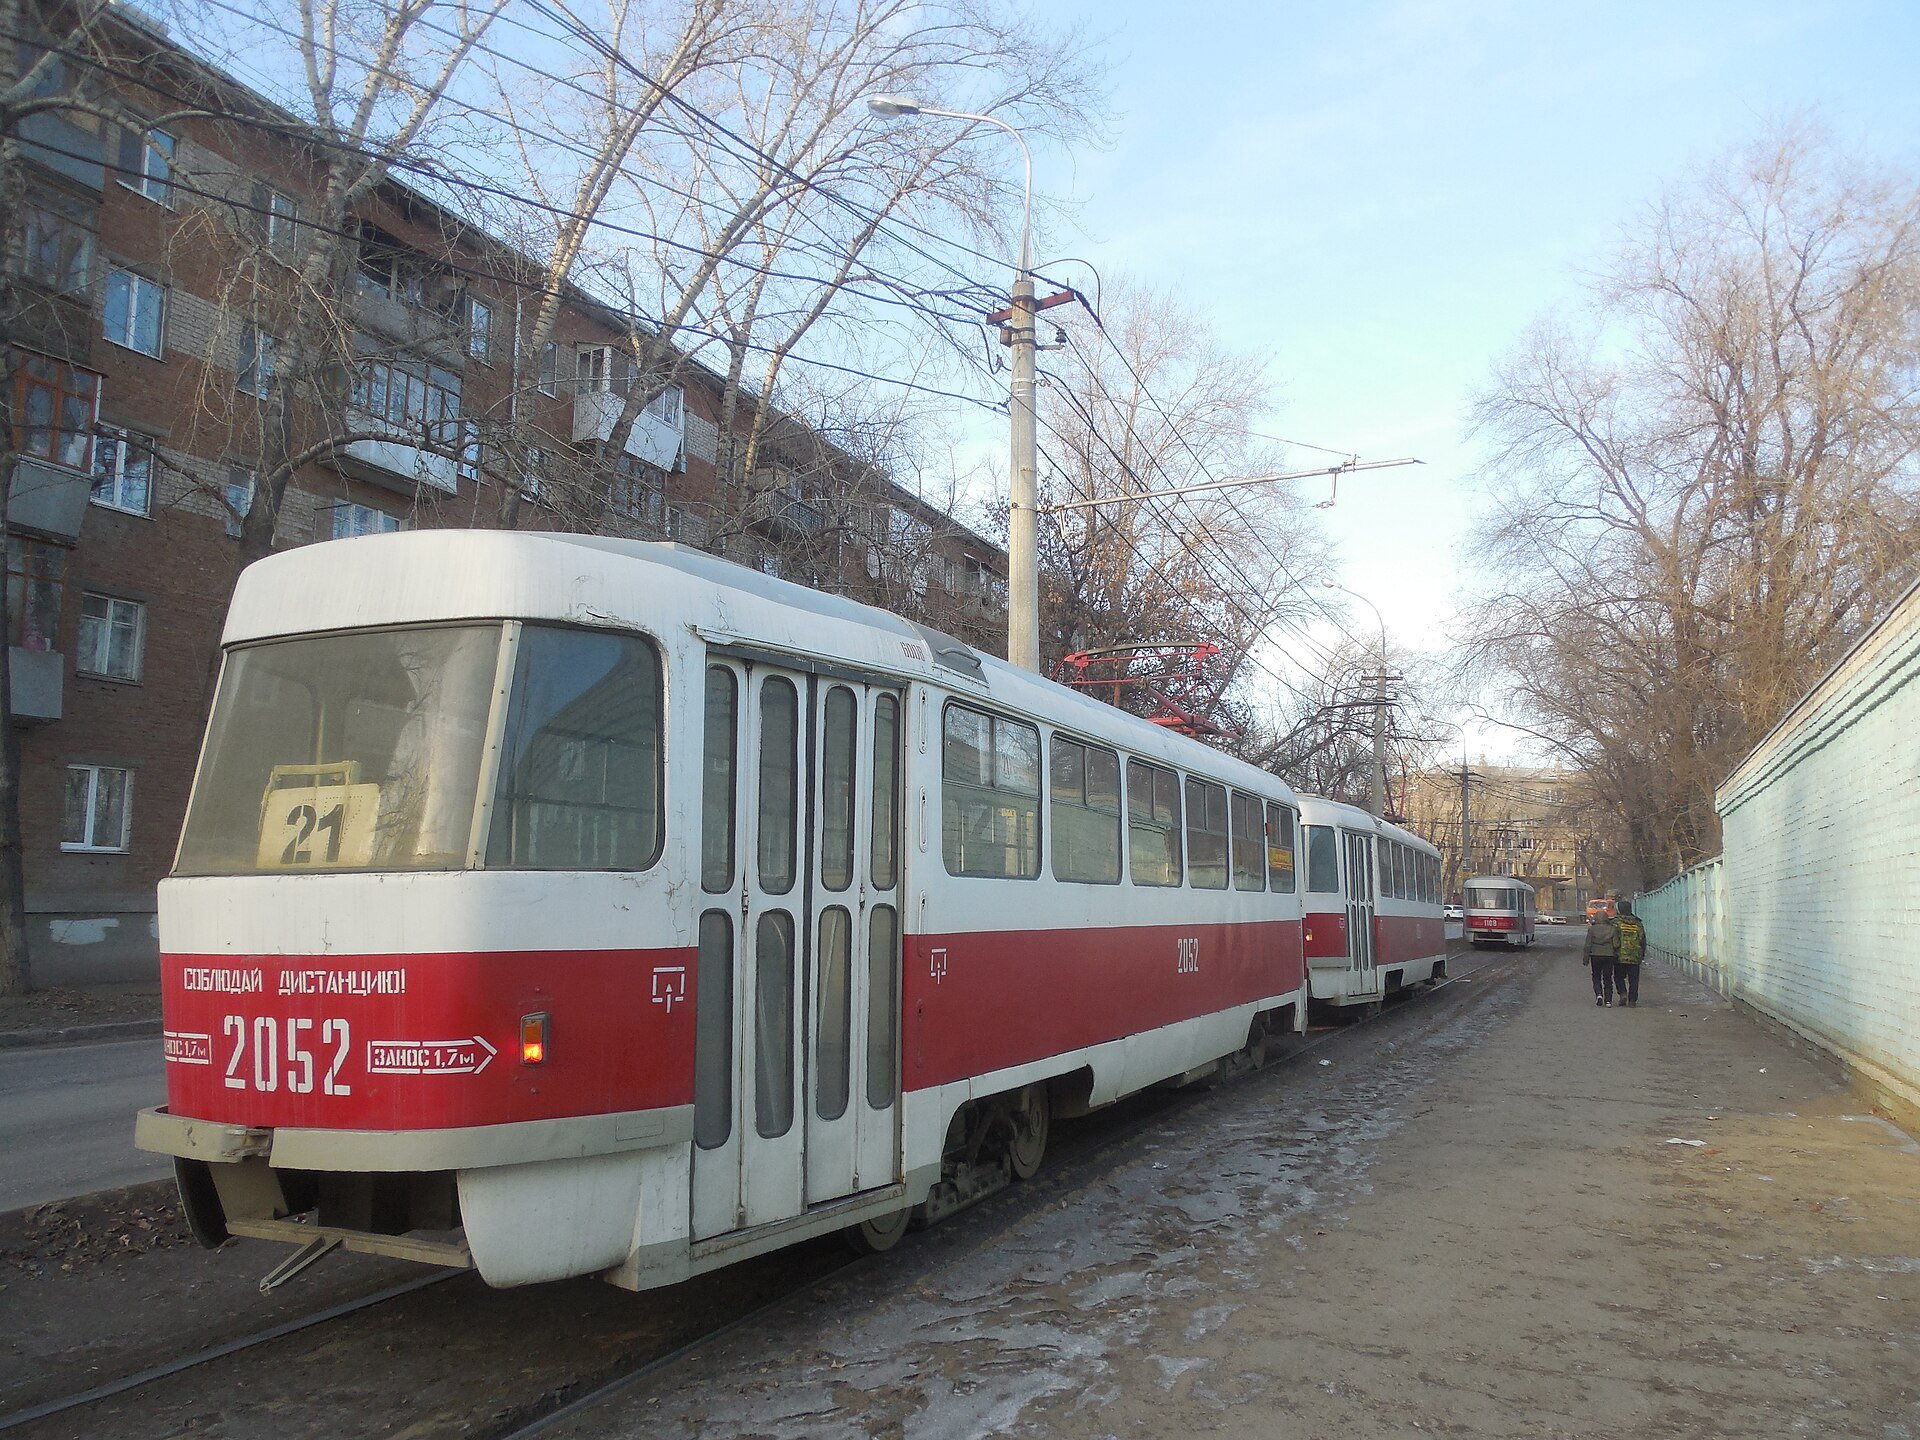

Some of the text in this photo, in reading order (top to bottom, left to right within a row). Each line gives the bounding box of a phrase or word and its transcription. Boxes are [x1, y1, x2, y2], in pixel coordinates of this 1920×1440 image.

[279, 803, 344, 864] 21
[1177, 938, 1199, 974] 2052
[183, 967, 406, 997] СОБЛЮДАЙ ДИСТАНЦИЮ!
[223, 1015, 351, 1096] 2052
[374, 1048, 430, 1067] ЗАНОС
